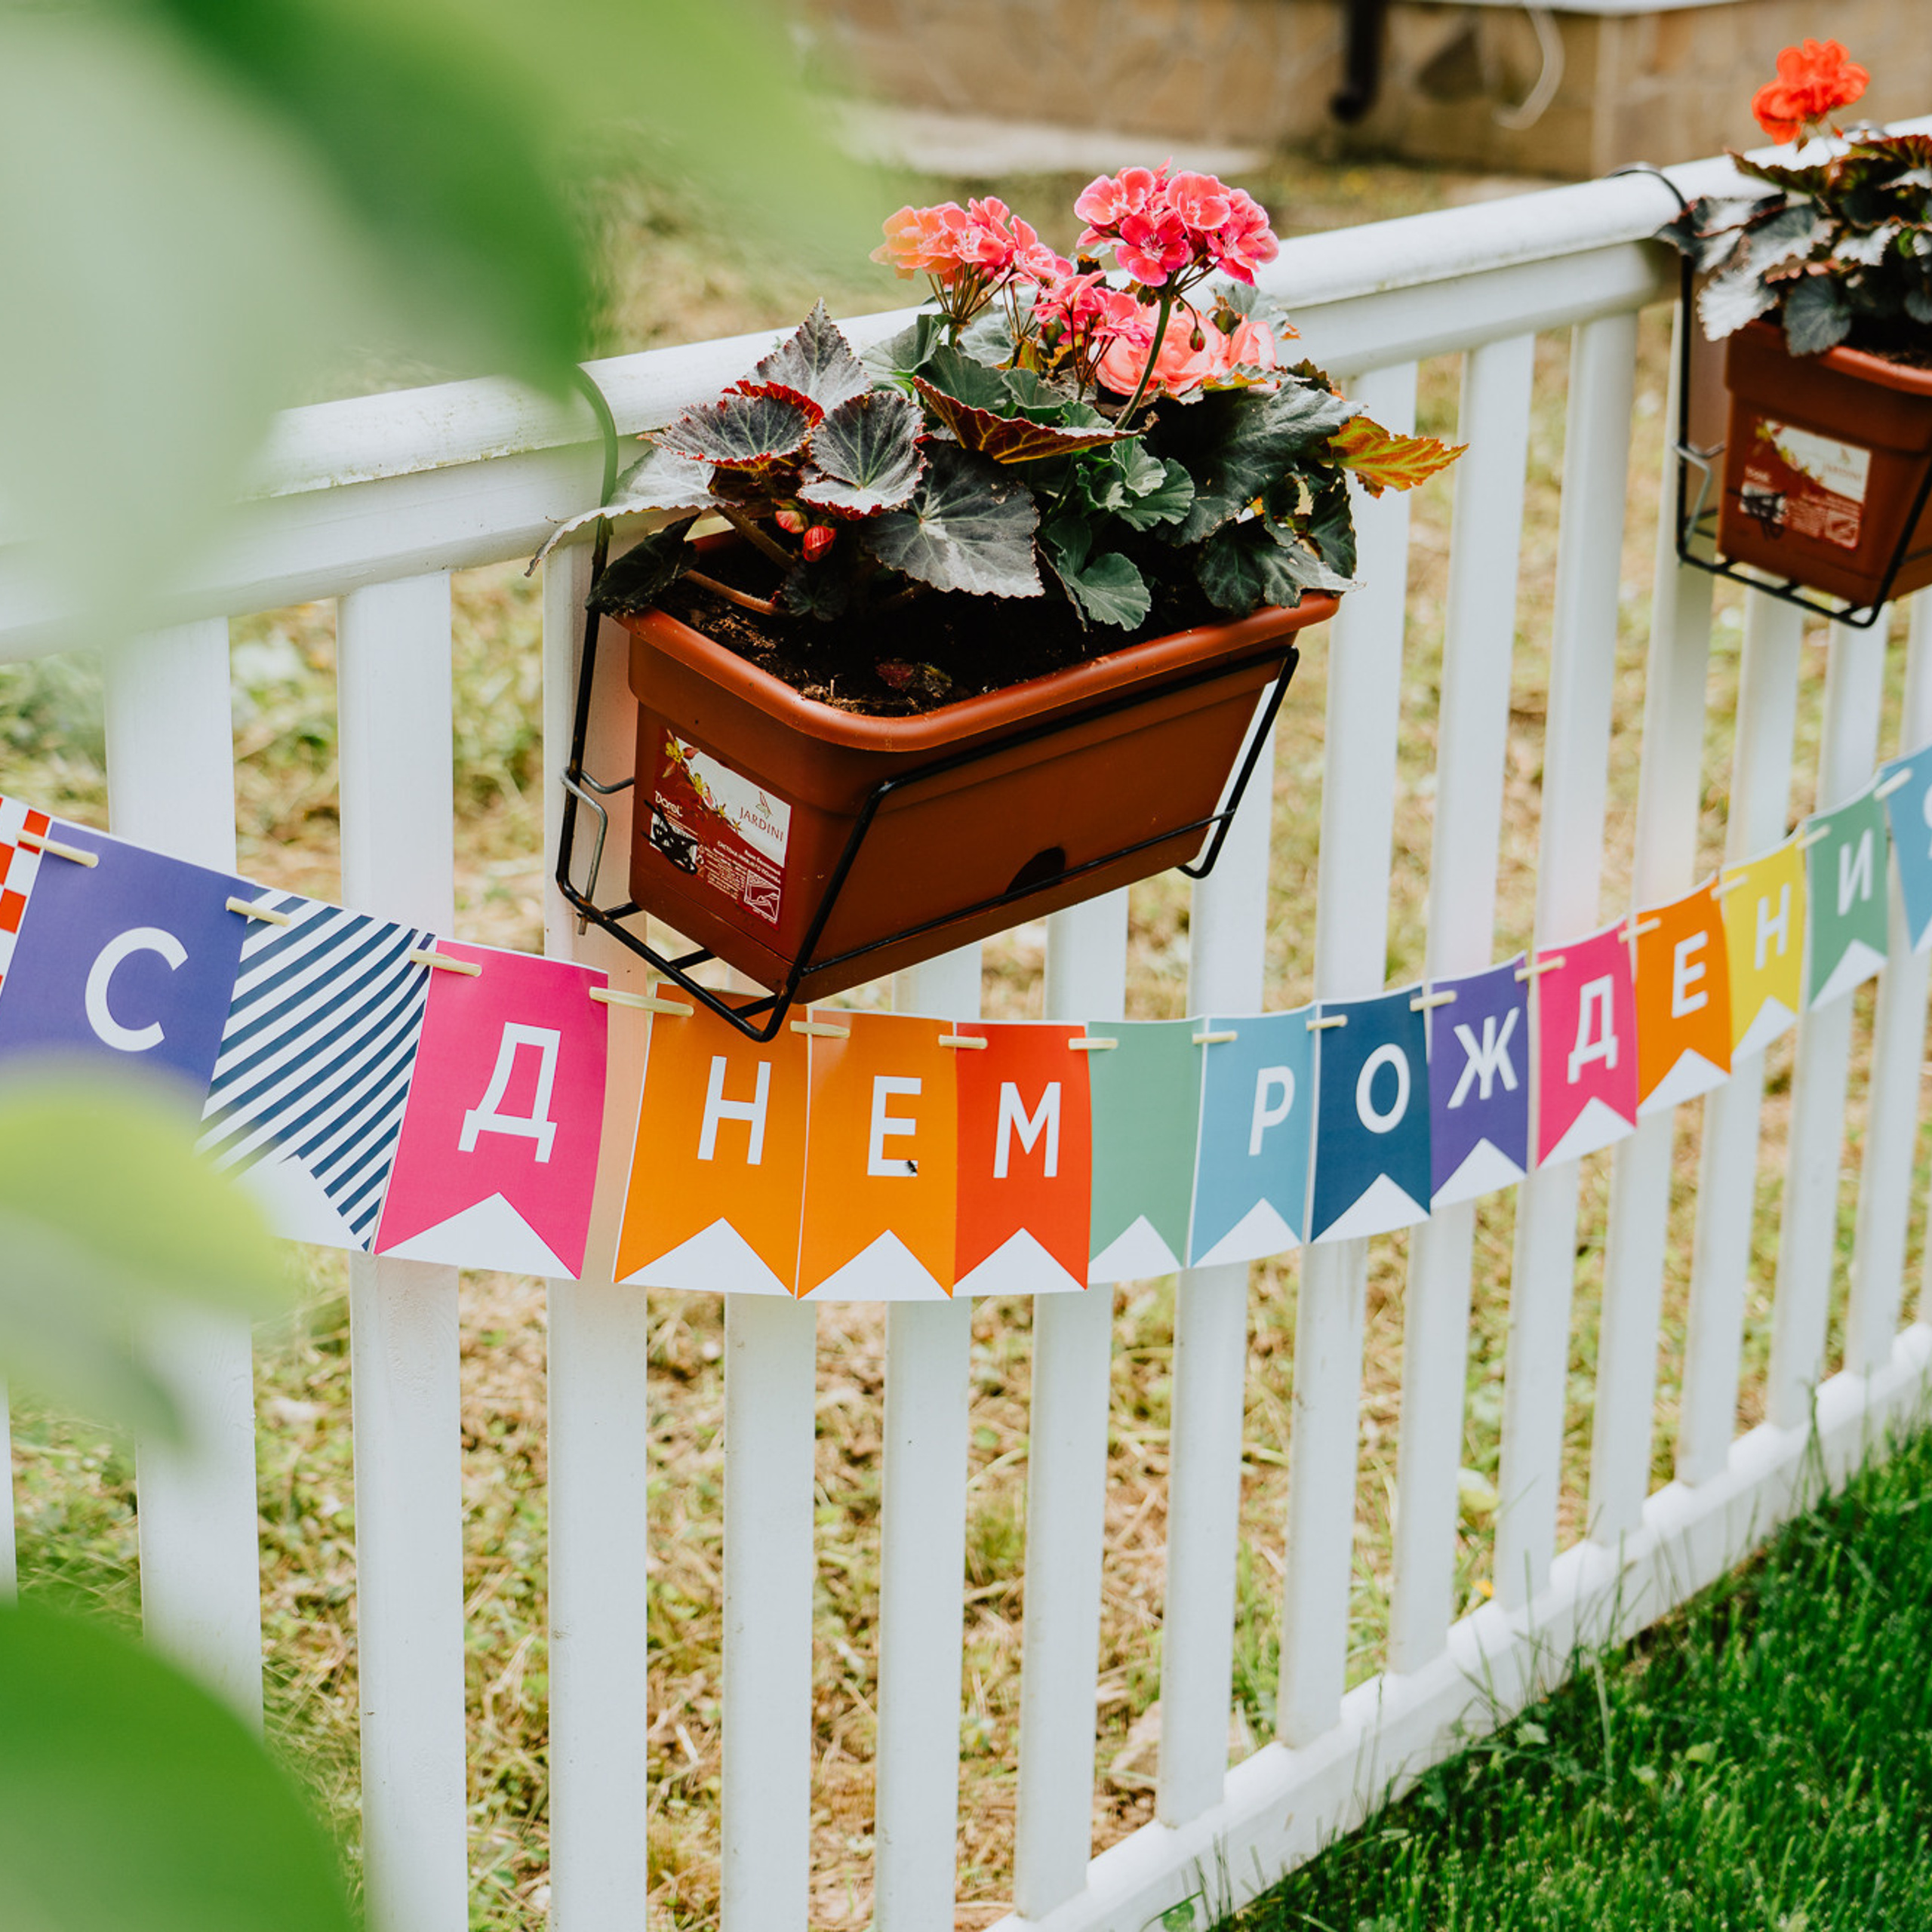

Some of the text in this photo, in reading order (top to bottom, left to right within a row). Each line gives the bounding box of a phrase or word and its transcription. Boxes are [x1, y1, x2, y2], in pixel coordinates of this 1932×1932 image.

[740, 807, 783, 842] JARDINI
[85, 783, 1932, 1178] С ДНЕМ РОЖДЕНИ
